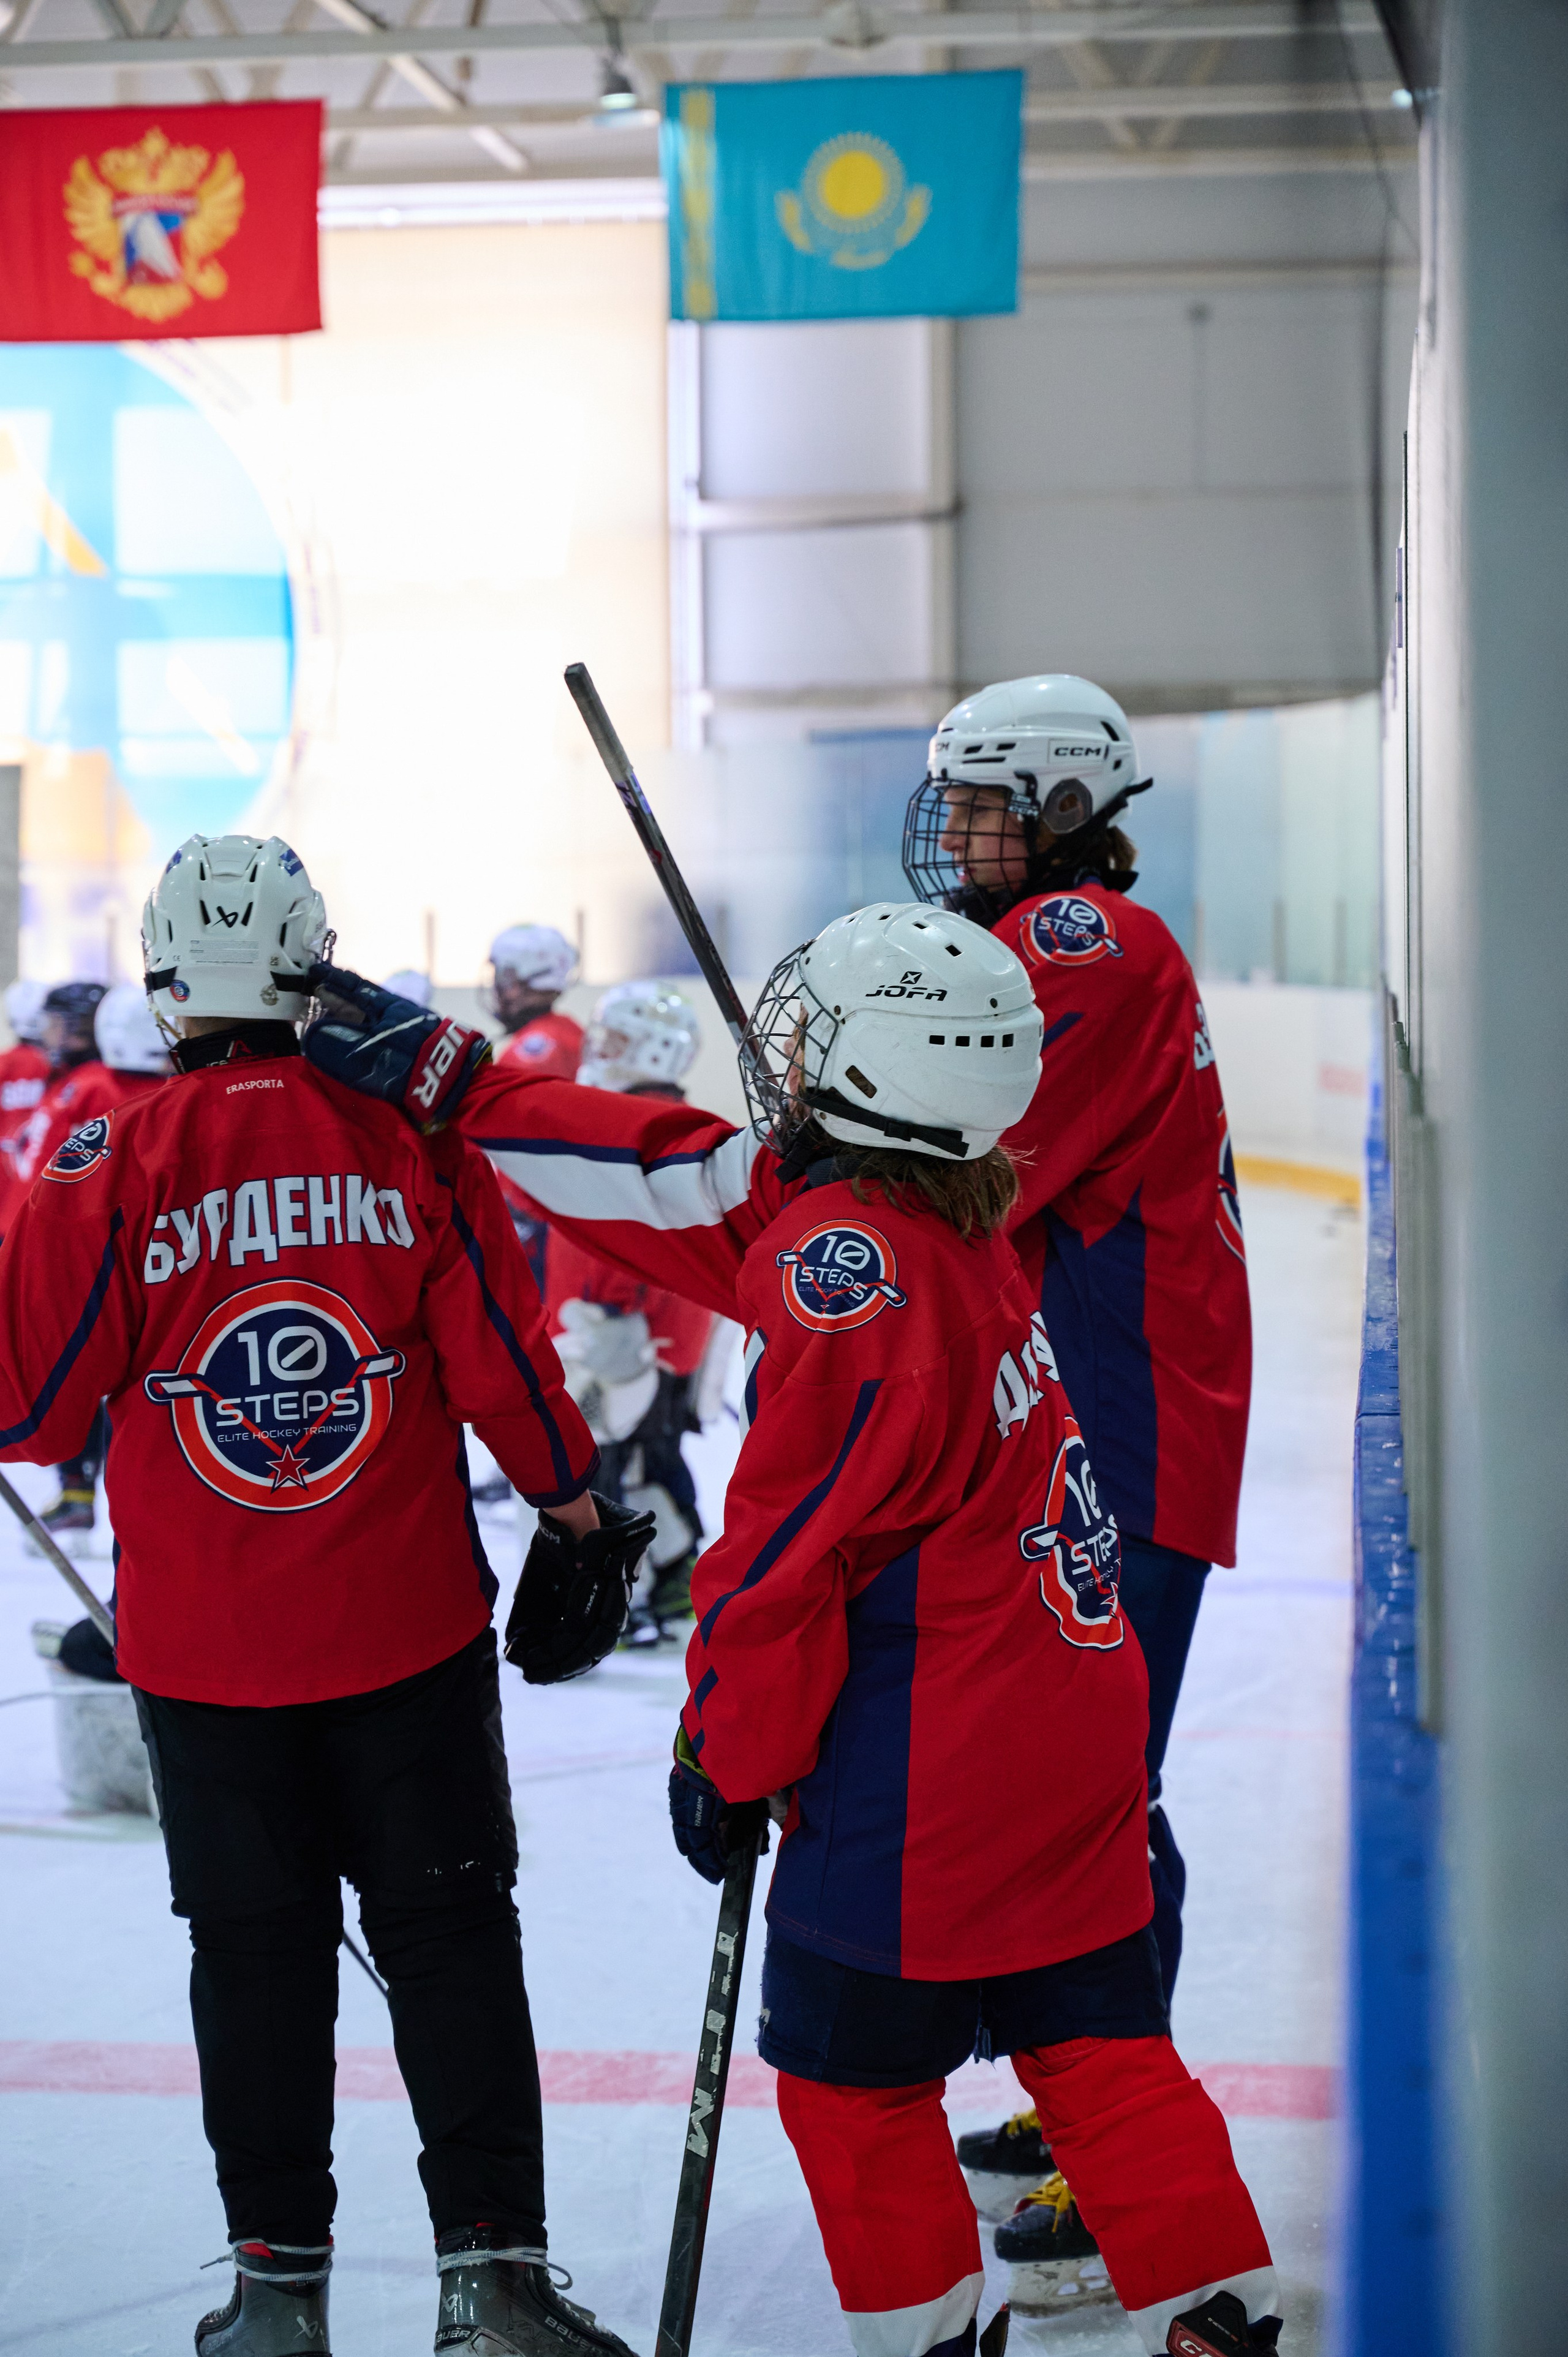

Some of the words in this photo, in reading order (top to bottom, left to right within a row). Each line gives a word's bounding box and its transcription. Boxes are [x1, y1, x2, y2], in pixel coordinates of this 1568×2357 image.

[1054, 747, 1101, 756] CCM
[1058, 899, 1098, 925] 10
[1037, 917, 1096, 946] STEPS
[865, 984, 948, 1001] JOFA
[411, 1020, 473, 1109] UER
[226, 1079, 285, 1095] ERASPORTA
[64, 1137, 94, 1161] EPS
[143, 1174, 416, 1284] БУРДЕНКО
[821, 1235, 871, 1270] 10
[799, 1266, 869, 1300] STEPS
[237, 1325, 328, 1386] 10
[216, 1387, 360, 1427] STEPS
[217, 1432, 249, 1443] ELITE
[252, 1428, 301, 1440] HOCKEY
[303, 1423, 357, 1436] TRAINING
[437, 2329, 471, 2343] AUER
